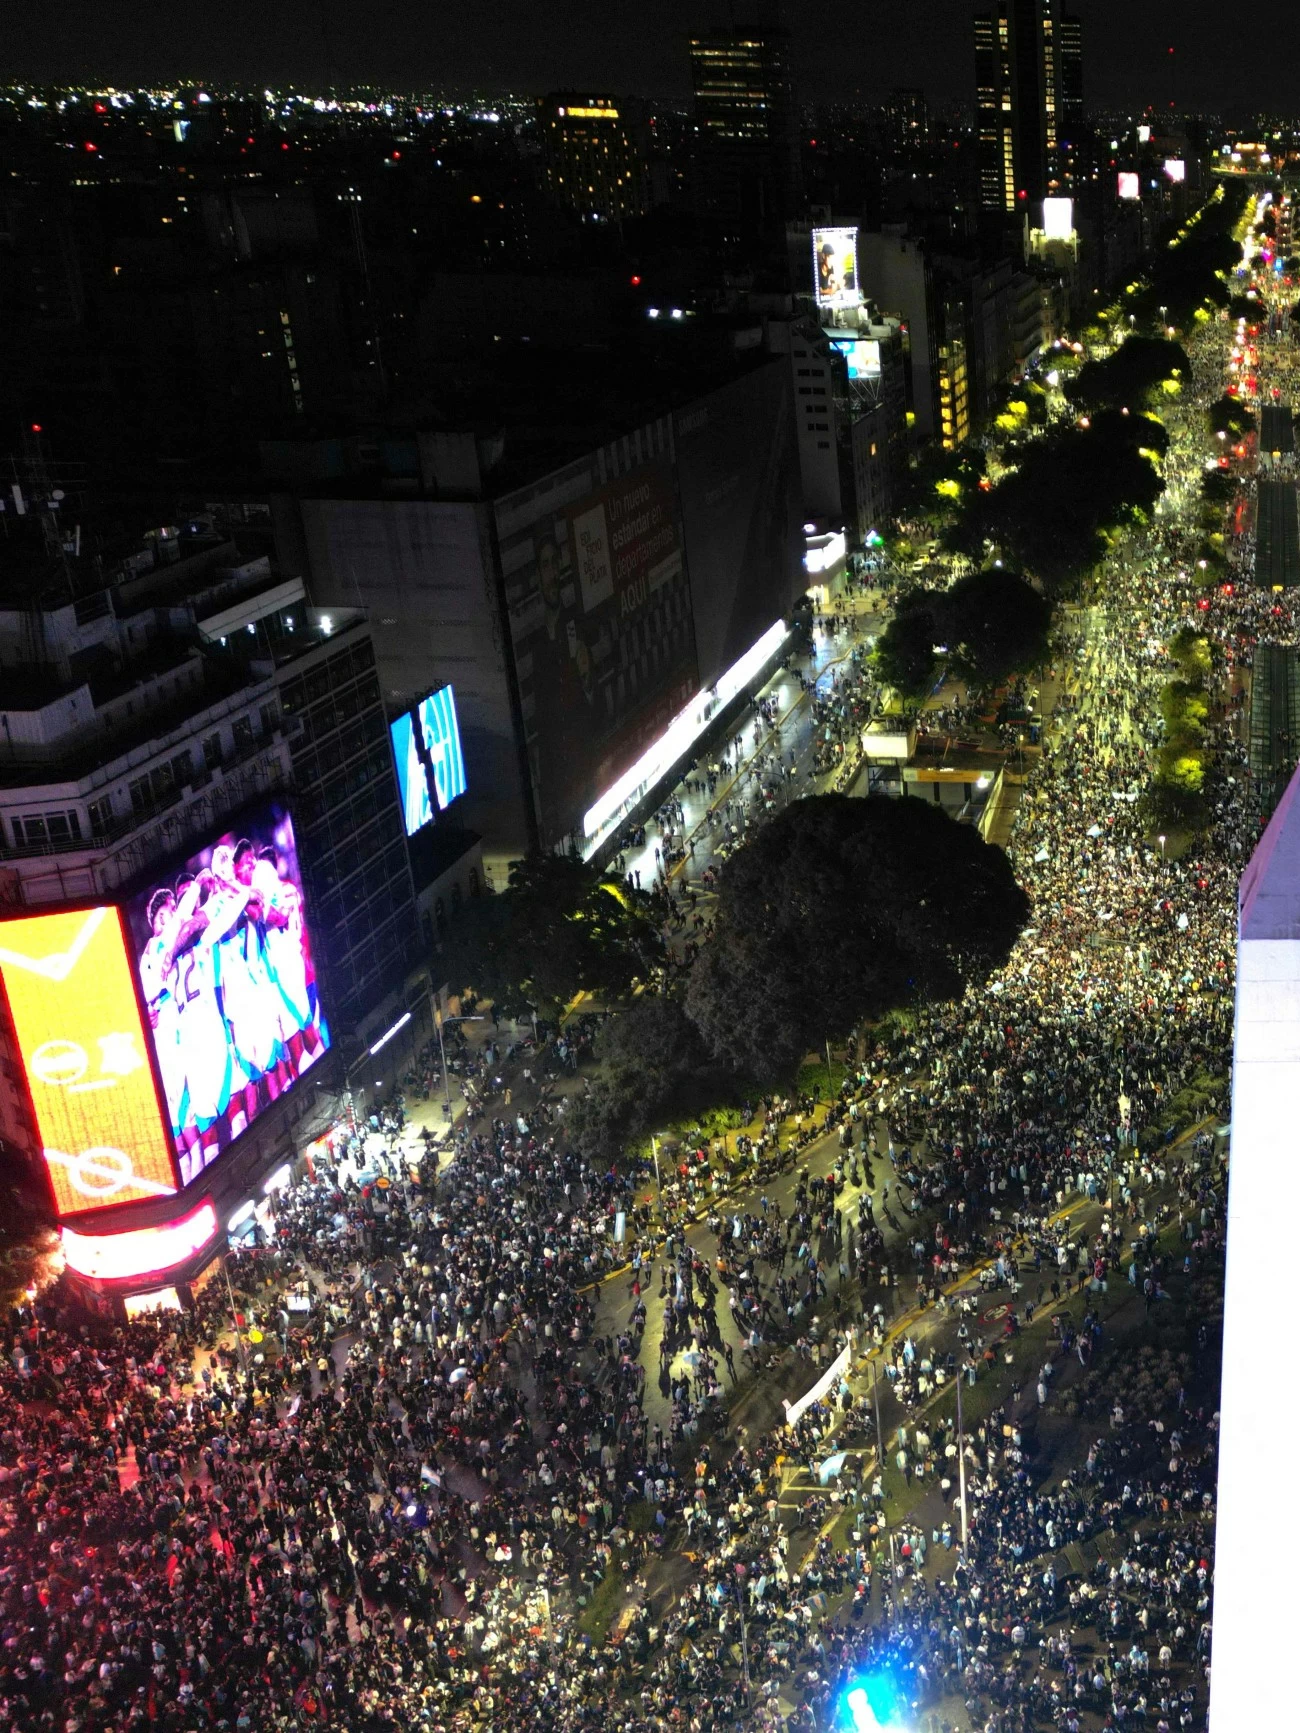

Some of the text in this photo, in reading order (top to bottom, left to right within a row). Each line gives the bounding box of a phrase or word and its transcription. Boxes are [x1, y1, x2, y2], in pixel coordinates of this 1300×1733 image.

[608, 483, 650, 521] Un nuevo
[612, 504, 663, 551] estándar en
[615, 524, 675, 579] departamentos
